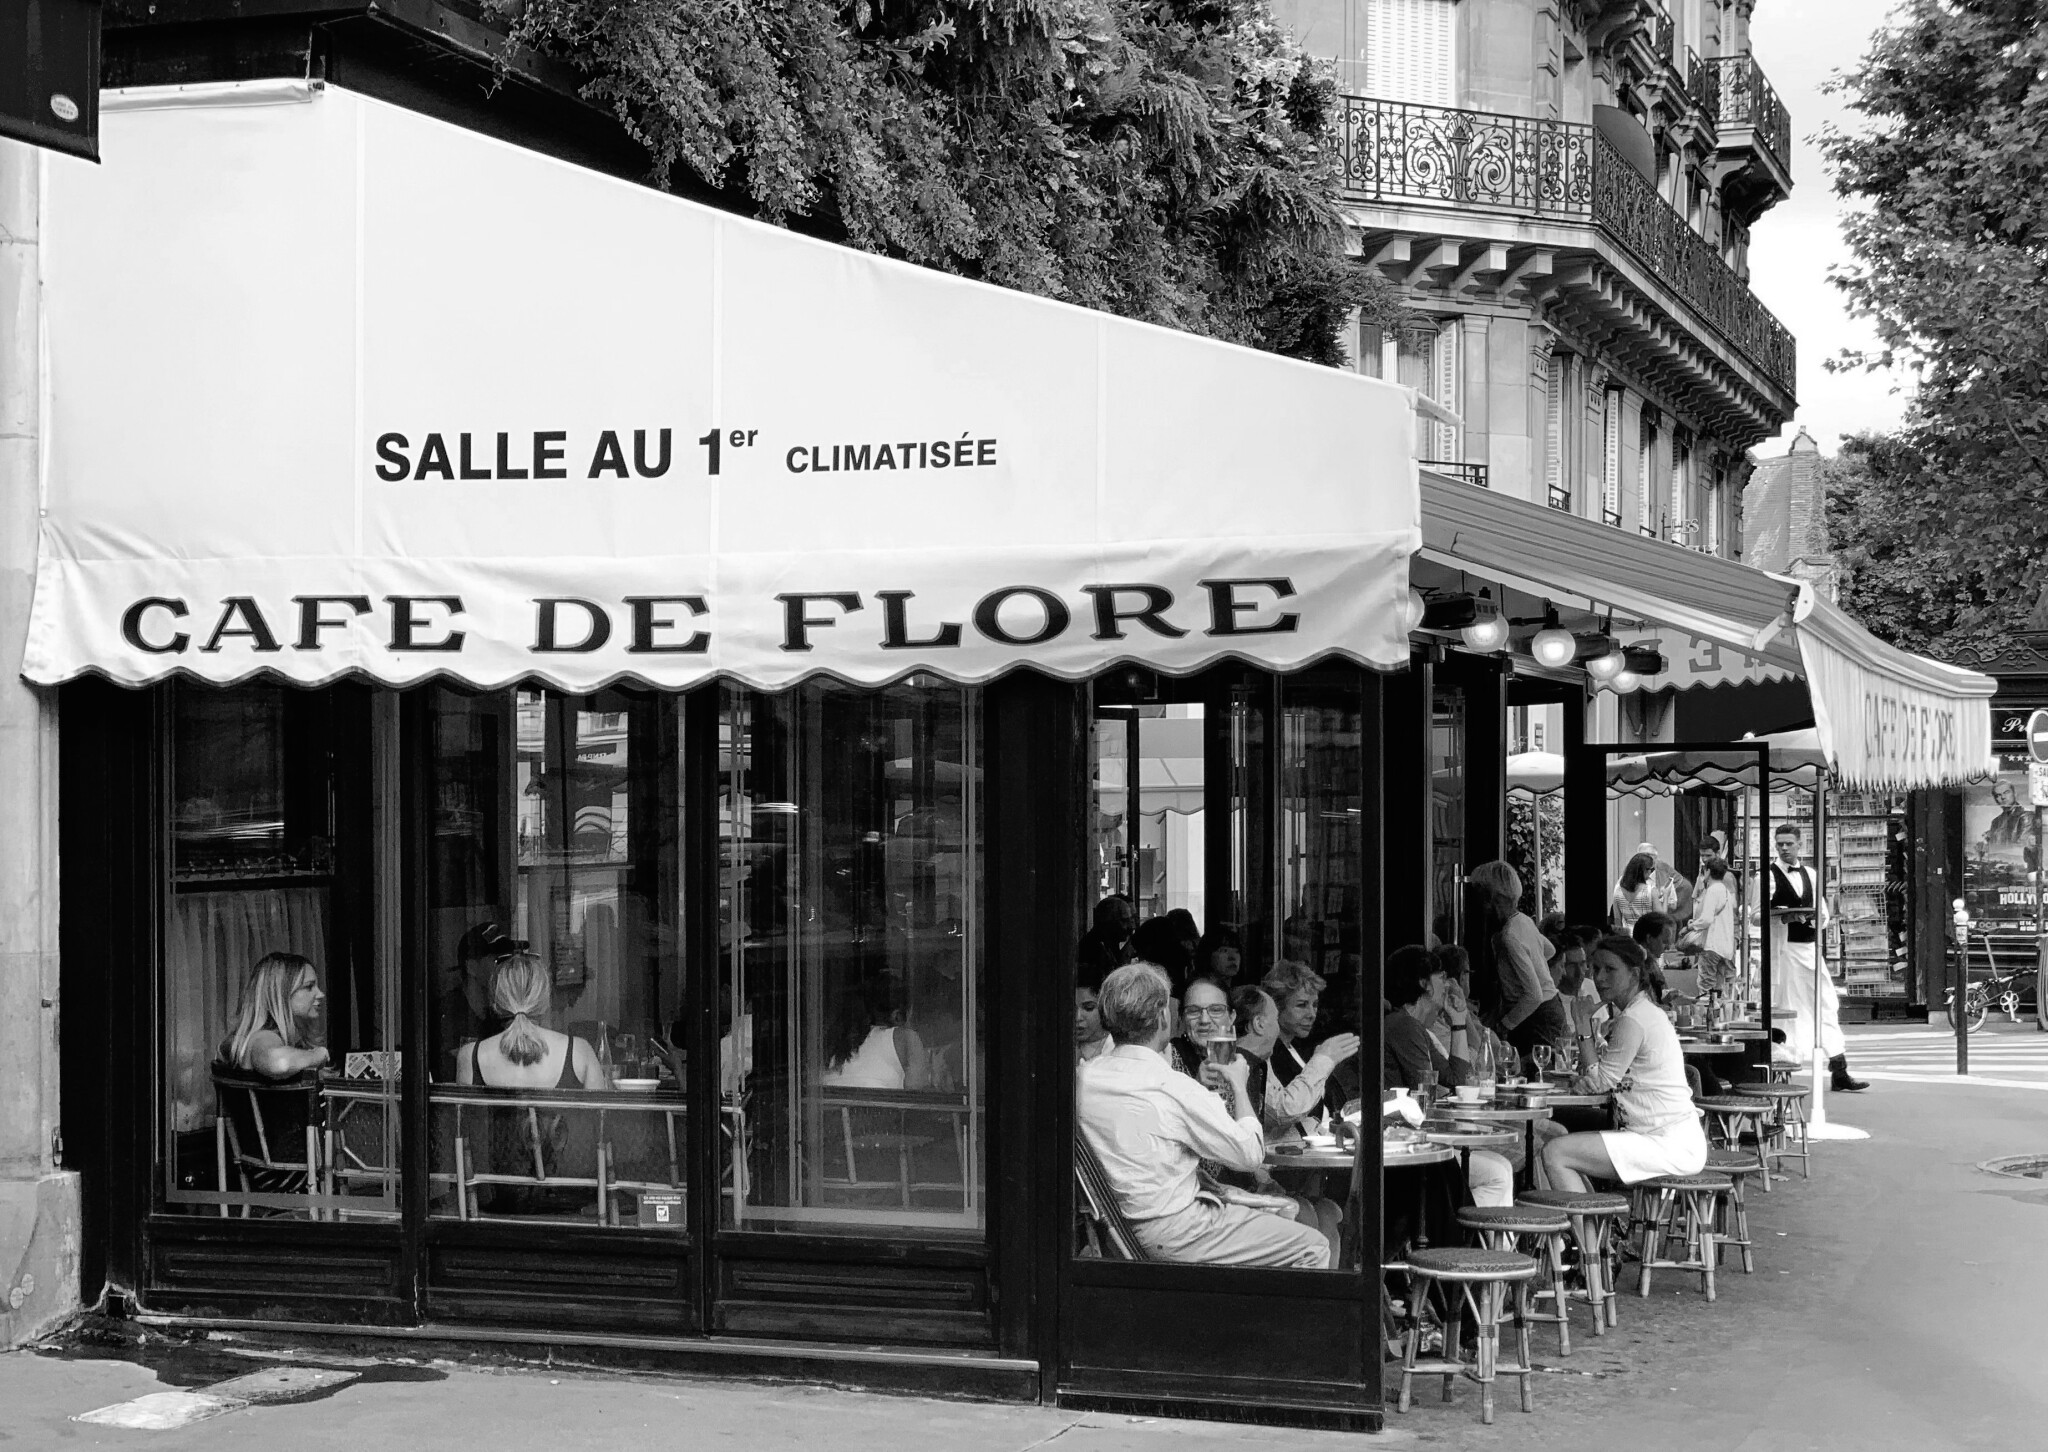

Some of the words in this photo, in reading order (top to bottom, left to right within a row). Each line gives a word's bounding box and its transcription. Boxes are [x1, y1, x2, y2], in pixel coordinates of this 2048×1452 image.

[375, 431, 567, 482] SALLE
[587, 429, 672, 479] AU
[699, 428, 758, 476] 1er
[786, 431, 998, 474] CLIMATISÉE
[120, 593, 469, 656] CAFE
[527, 594, 713, 657] DE
[773, 576, 1303, 653] FLORE
[1865, 692, 1897, 761] CAFE
[2001, 717, 2028, 733] Pr
[2038, 766, 2048, 777] SA
